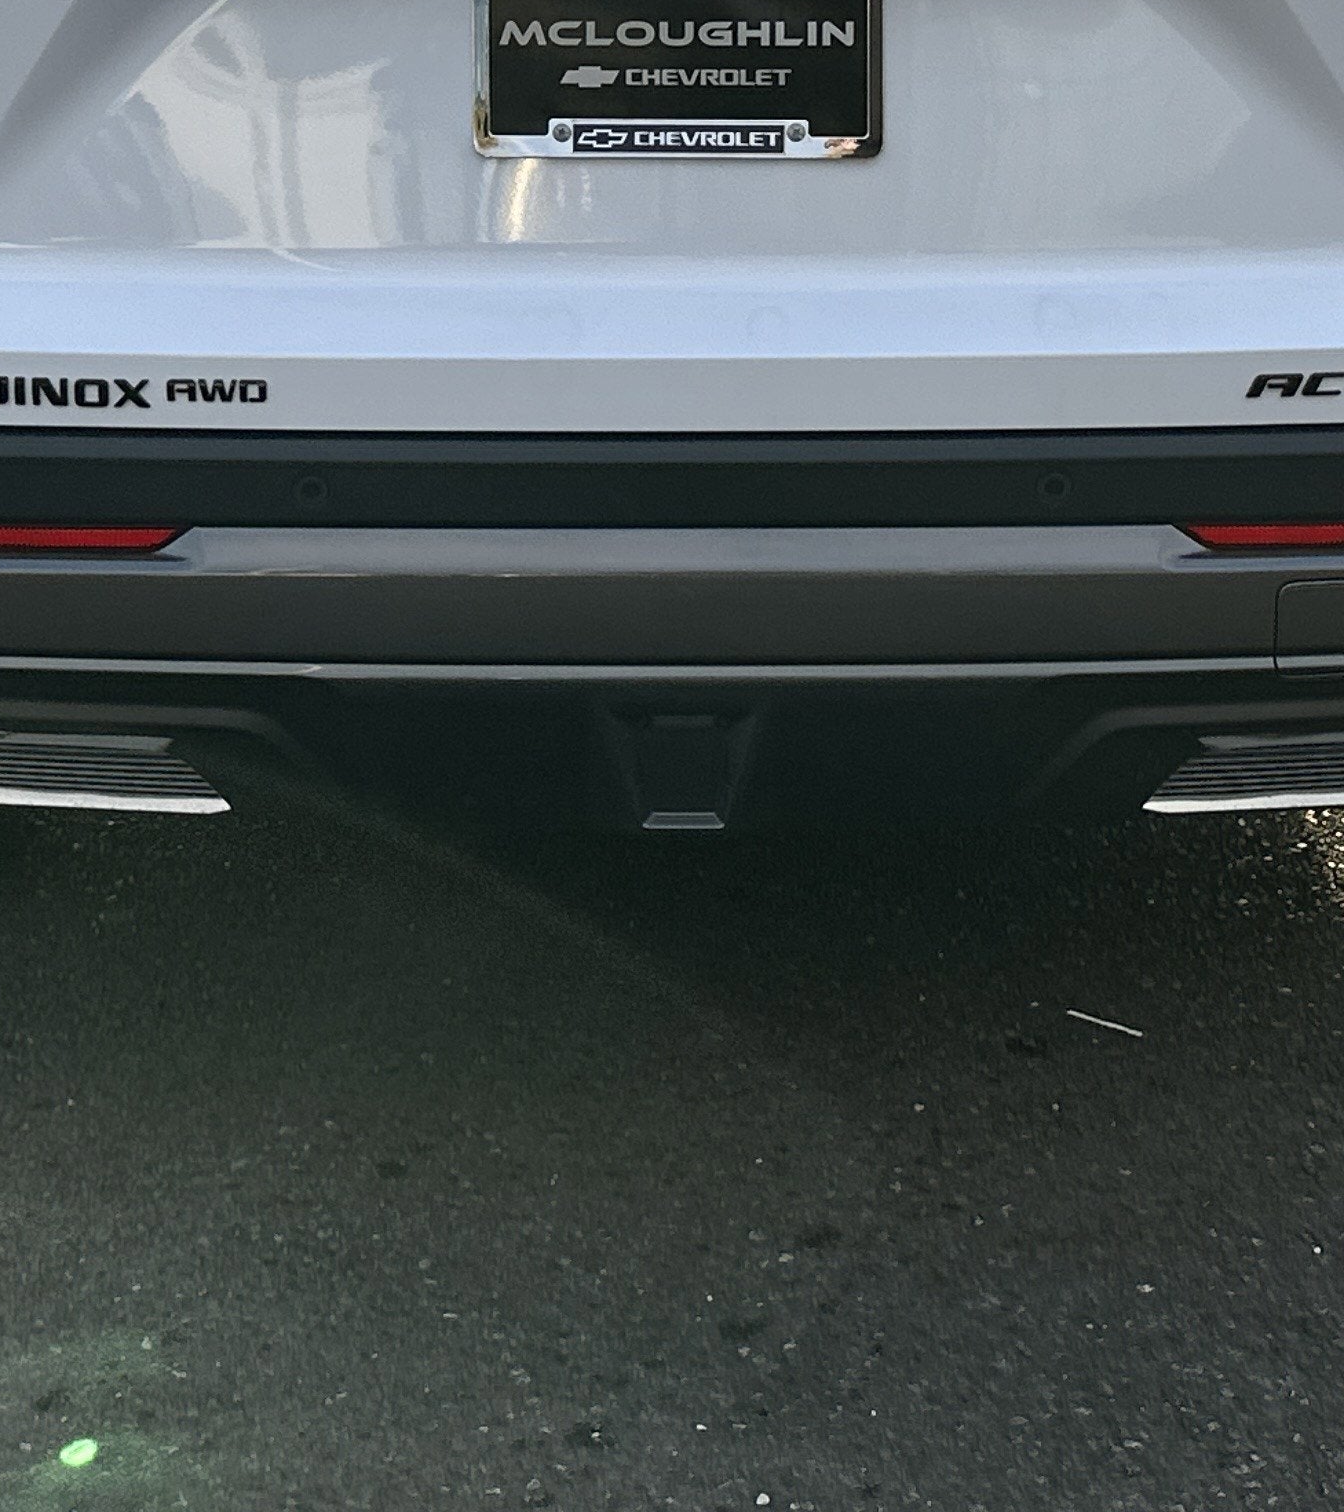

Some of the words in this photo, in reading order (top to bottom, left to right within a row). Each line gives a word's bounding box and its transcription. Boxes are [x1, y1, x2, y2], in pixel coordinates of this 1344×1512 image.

[498, 20, 855, 48] MCLOUGHLIN
[624, 68, 793, 87] CHEVROLET
[633, 131, 782, 147] CHEVROLET
[165, 377, 269, 404] AWD
